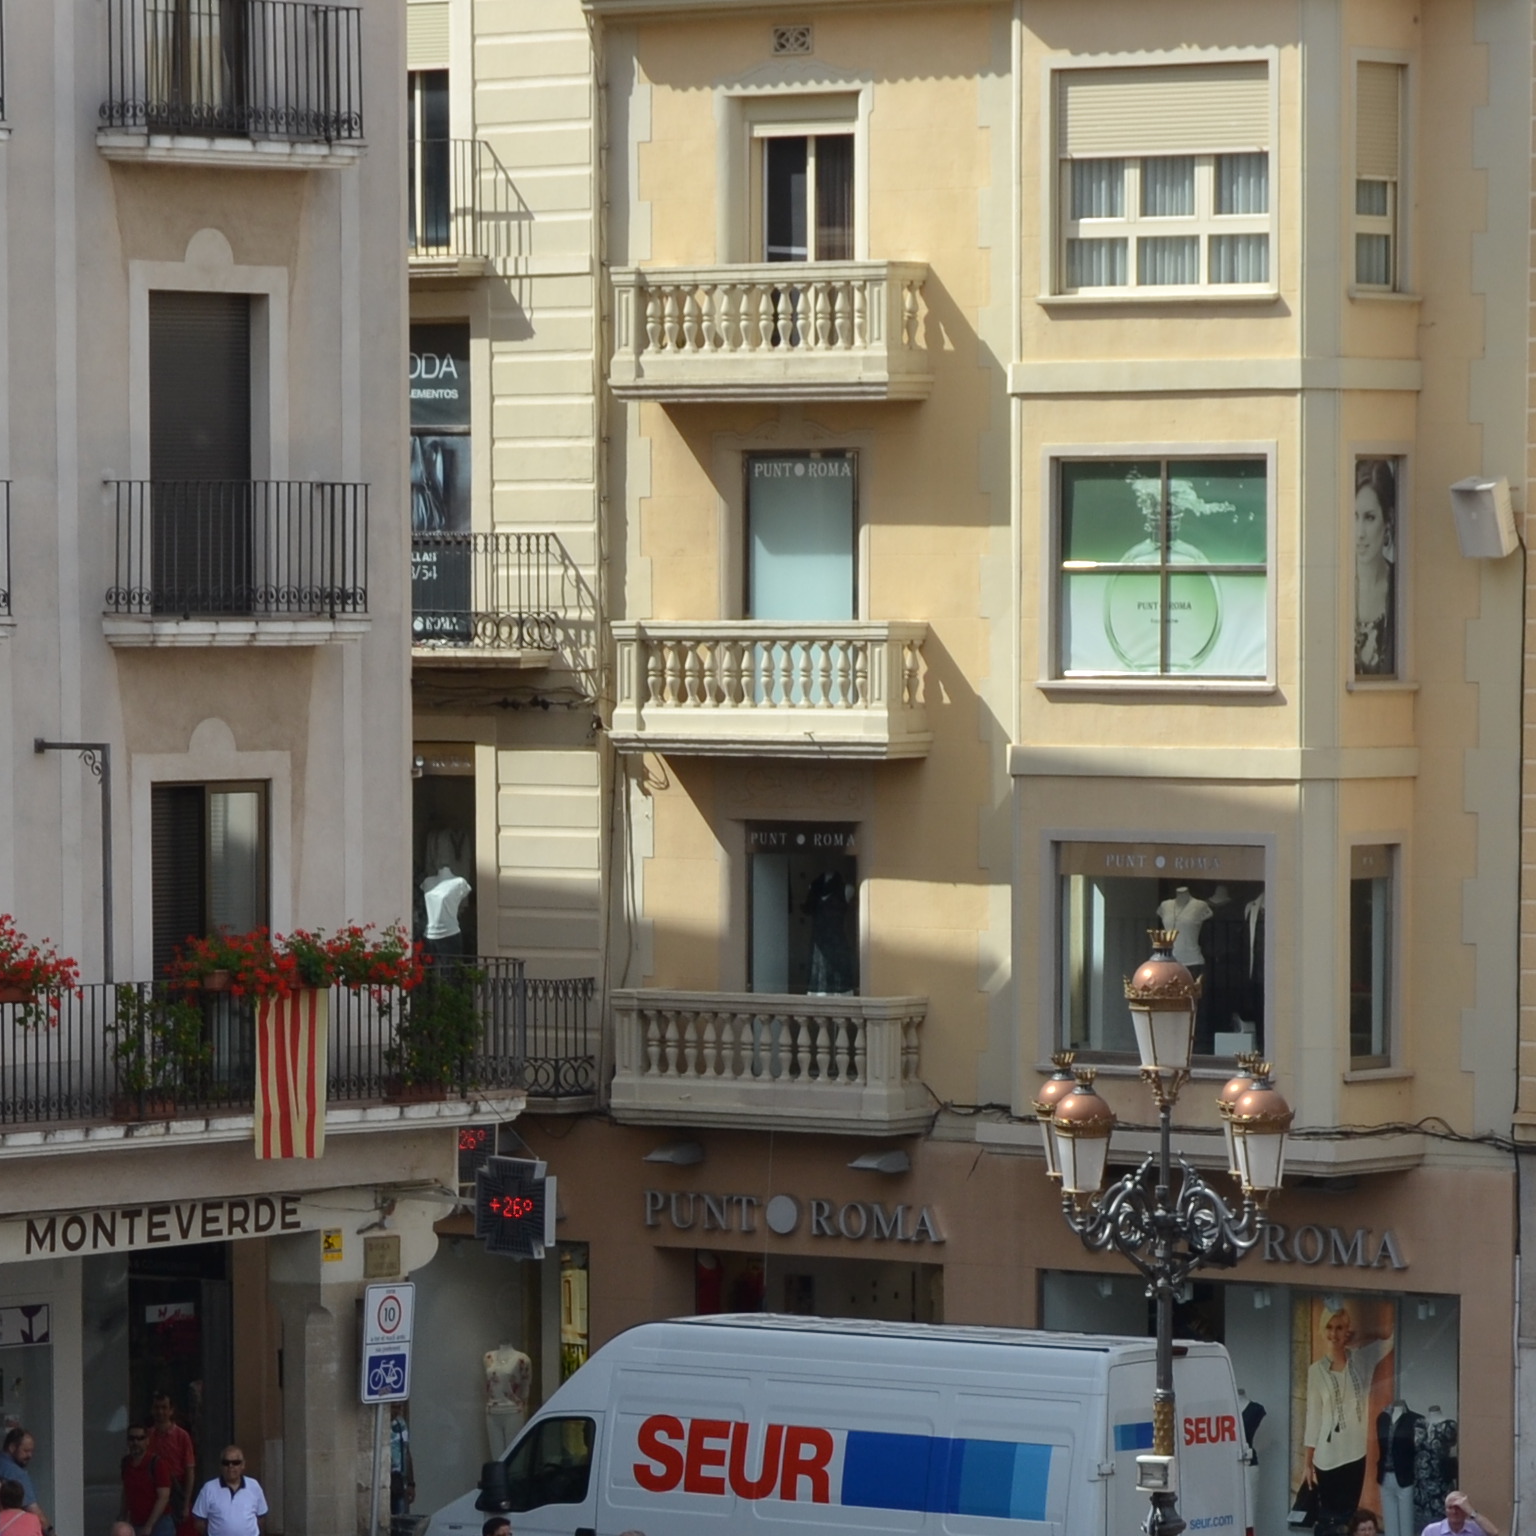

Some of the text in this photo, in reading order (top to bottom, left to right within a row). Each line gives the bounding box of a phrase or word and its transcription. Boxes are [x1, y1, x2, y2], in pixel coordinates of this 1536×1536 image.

[808, 462, 852, 478] ROMA
[814, 833, 856, 847] ROMA
[25, 1196, 302, 1255] MONTEVERDE
[811, 1200, 947, 1243] ROMA
[1264, 1224, 1409, 1269] ROMA
[384, 1307, 396, 1323] 10
[1184, 1415, 1236, 1446] SEUR
[633, 1414, 834, 1504] SEUR
[1189, 1514, 1234, 1531] seur.com
